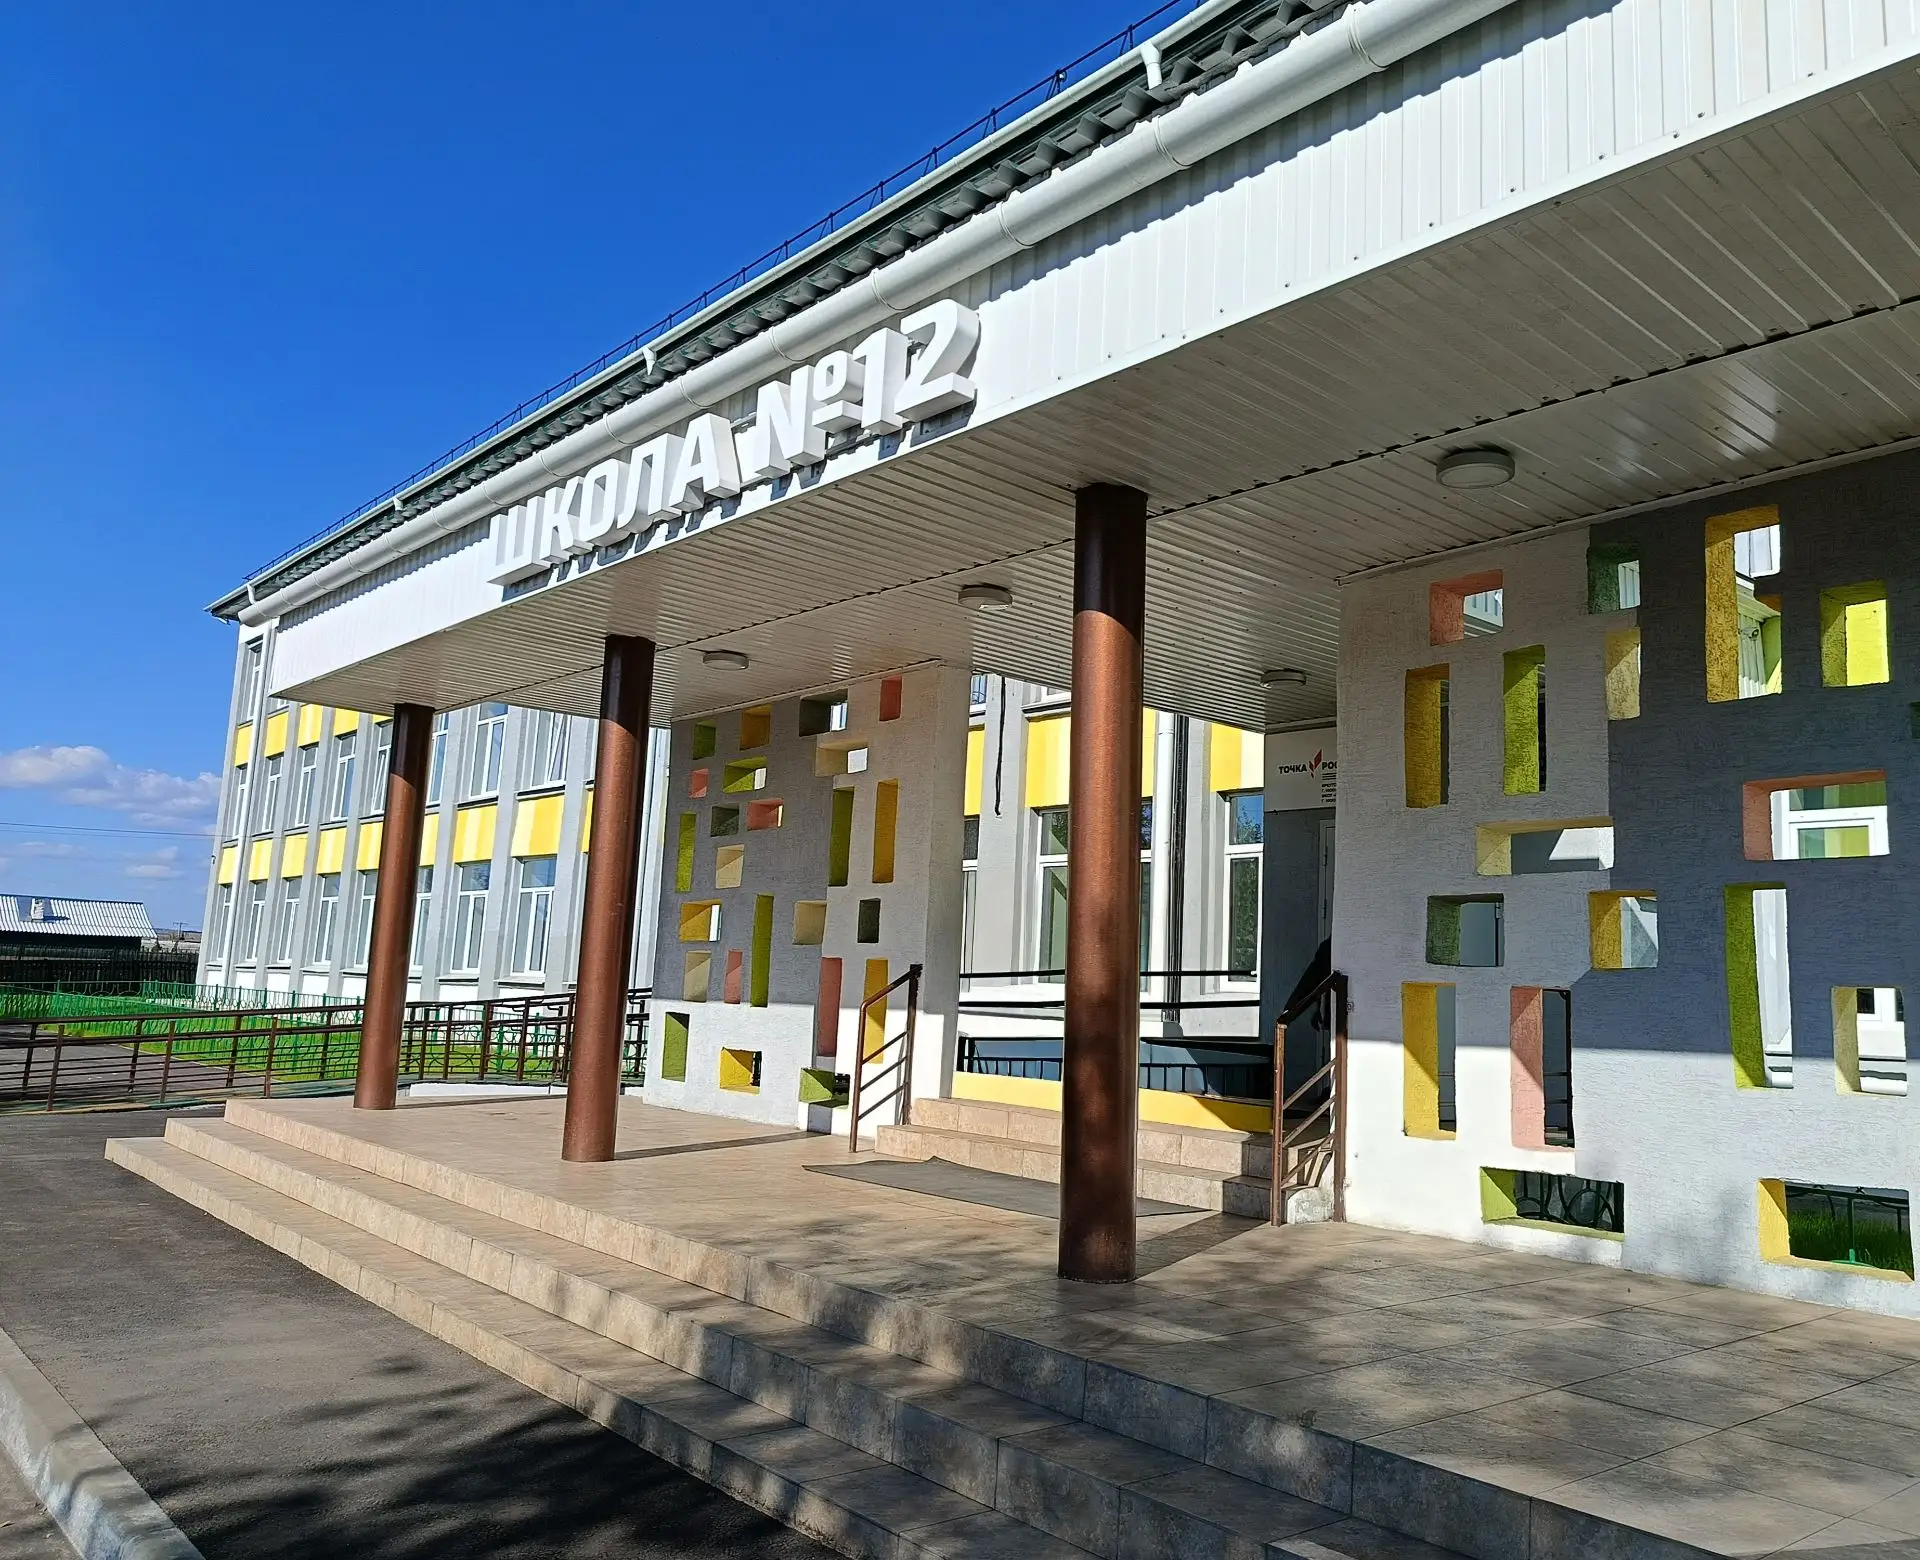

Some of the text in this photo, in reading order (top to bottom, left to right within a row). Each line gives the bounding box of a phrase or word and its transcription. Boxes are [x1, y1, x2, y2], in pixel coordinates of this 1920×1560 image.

[487, 298, 980, 586] ШКОЛА №12
[1279, 764, 1307, 774] ТОЧКА
